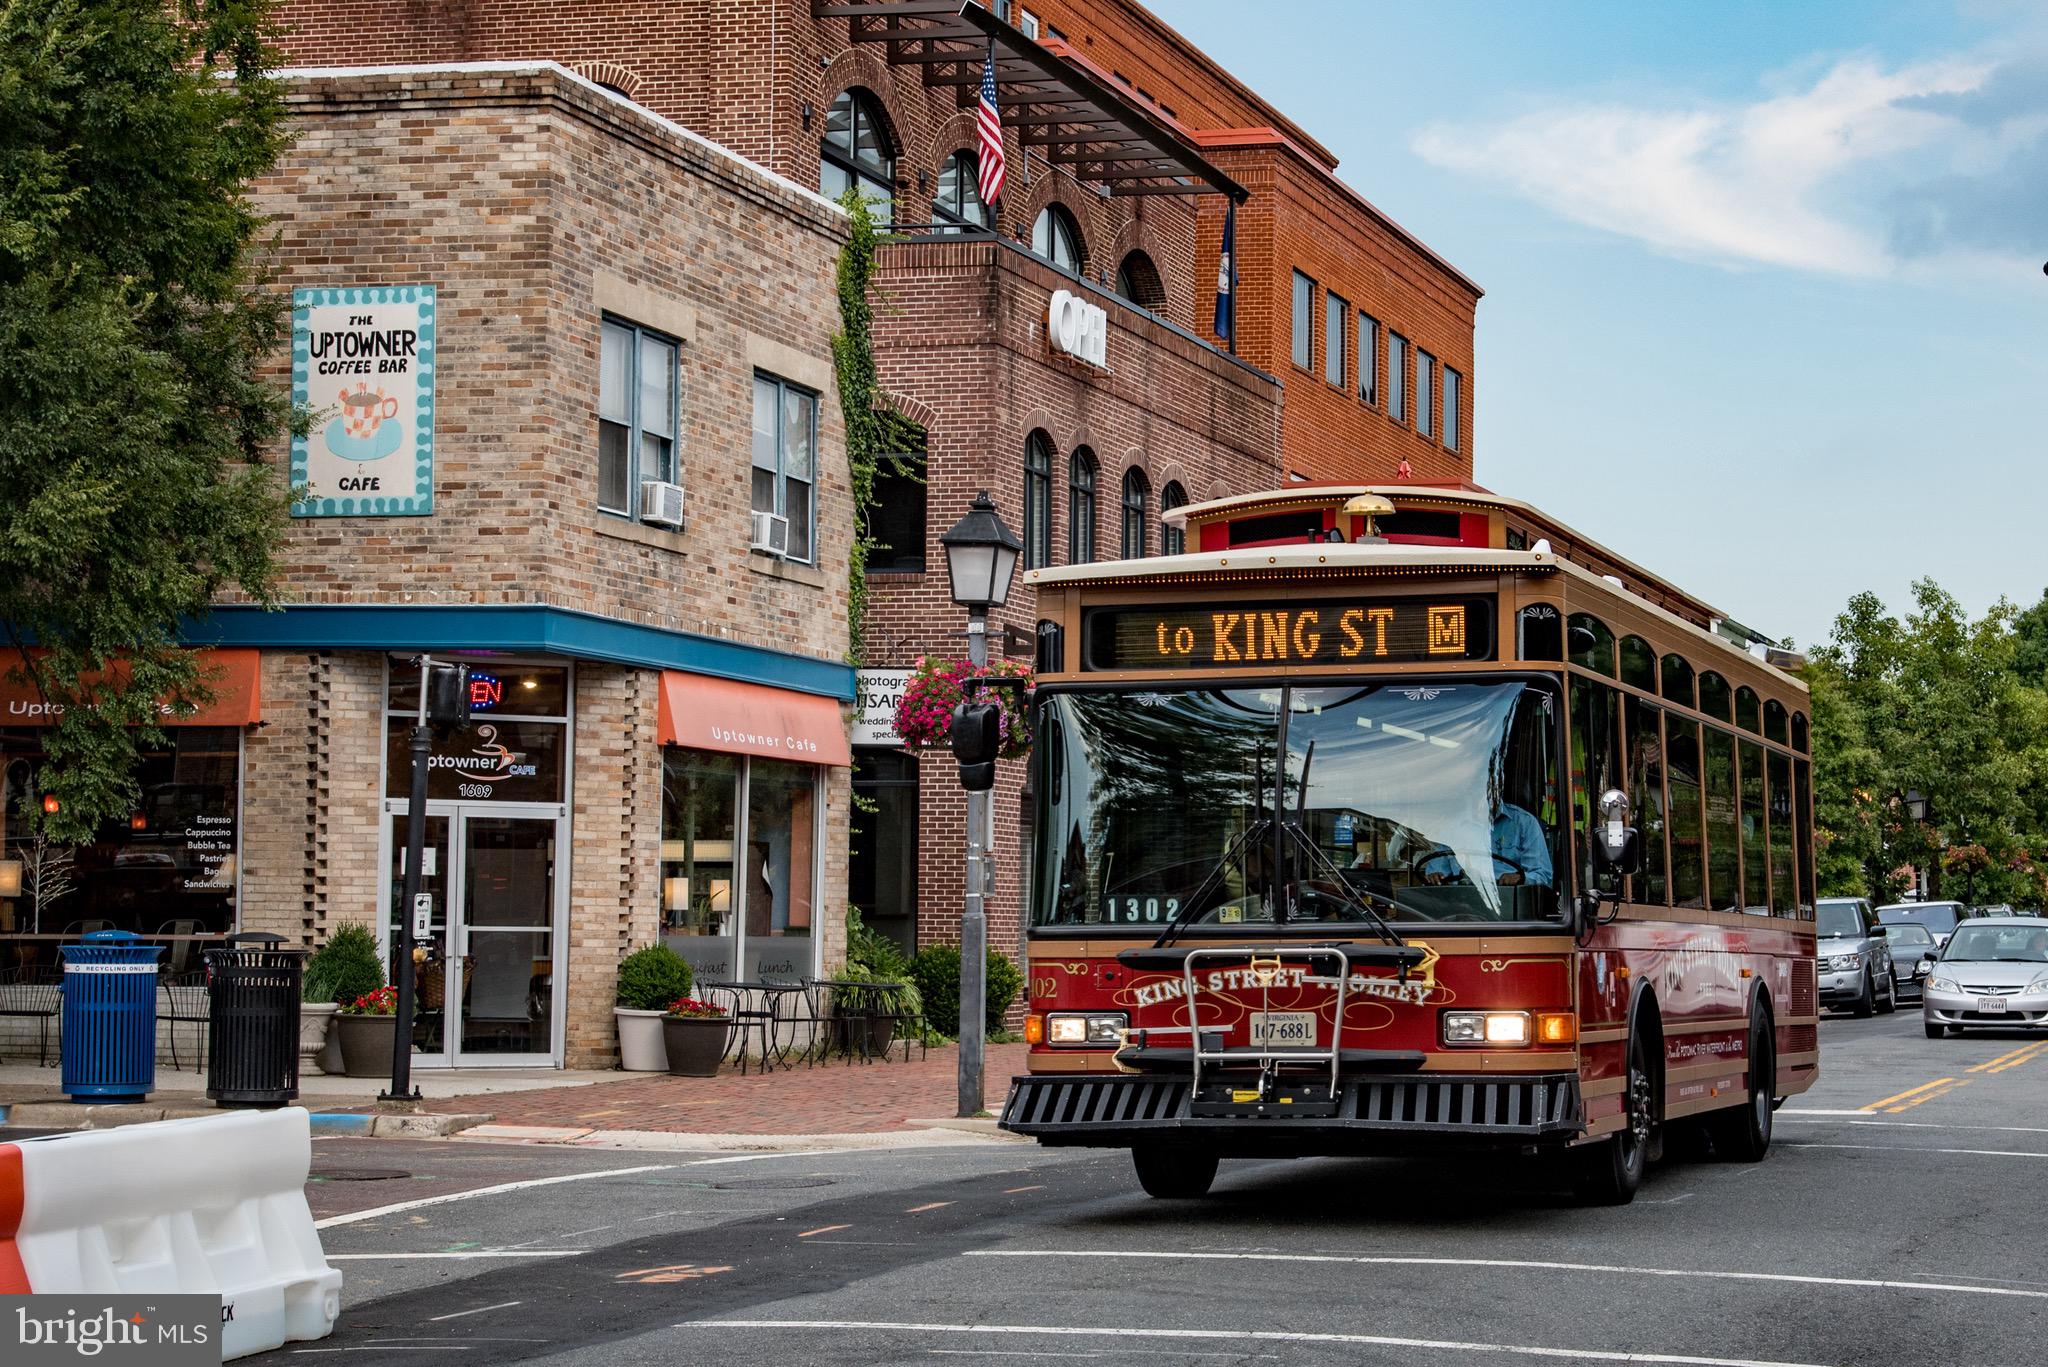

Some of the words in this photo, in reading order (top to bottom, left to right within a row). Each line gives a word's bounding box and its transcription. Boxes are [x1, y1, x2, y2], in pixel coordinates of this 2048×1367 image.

[349, 315, 373, 326] THE
[310, 330, 417, 358] UPTOWNER
[318, 360, 372, 375] COFFEE
[378, 359, 408, 374] BAR
[339, 477, 381, 491] CAFE
[1156, 622, 1194, 655] to
[1212, 610, 1321, 661] KING
[1340, 608, 1396, 657] ST
[471, 681, 502, 702] EN
[711, 726, 779, 747] Uptowner
[786, 736, 817, 752] Cafe
[872, 731, 899, 740] specia
[428, 754, 497, 771] ptowner
[459, 783, 493, 798] 1609
[197, 815, 232, 826] Espresso
[185, 828, 232, 838] Cappuccino
[187, 841, 216, 849] Bubble
[217, 841, 231, 849] Tea
[184, 879, 230, 888] Sandwiches
[1108, 898, 1180, 922] 1302
[757, 960, 795, 974] Lunch
[1135, 976, 1200, 1008] KING
[1208, 967, 1307, 992] STREET
[1315, 973, 1433, 1007] OLLEY
[1267, 1014, 1299, 1022] VIRGINIA
